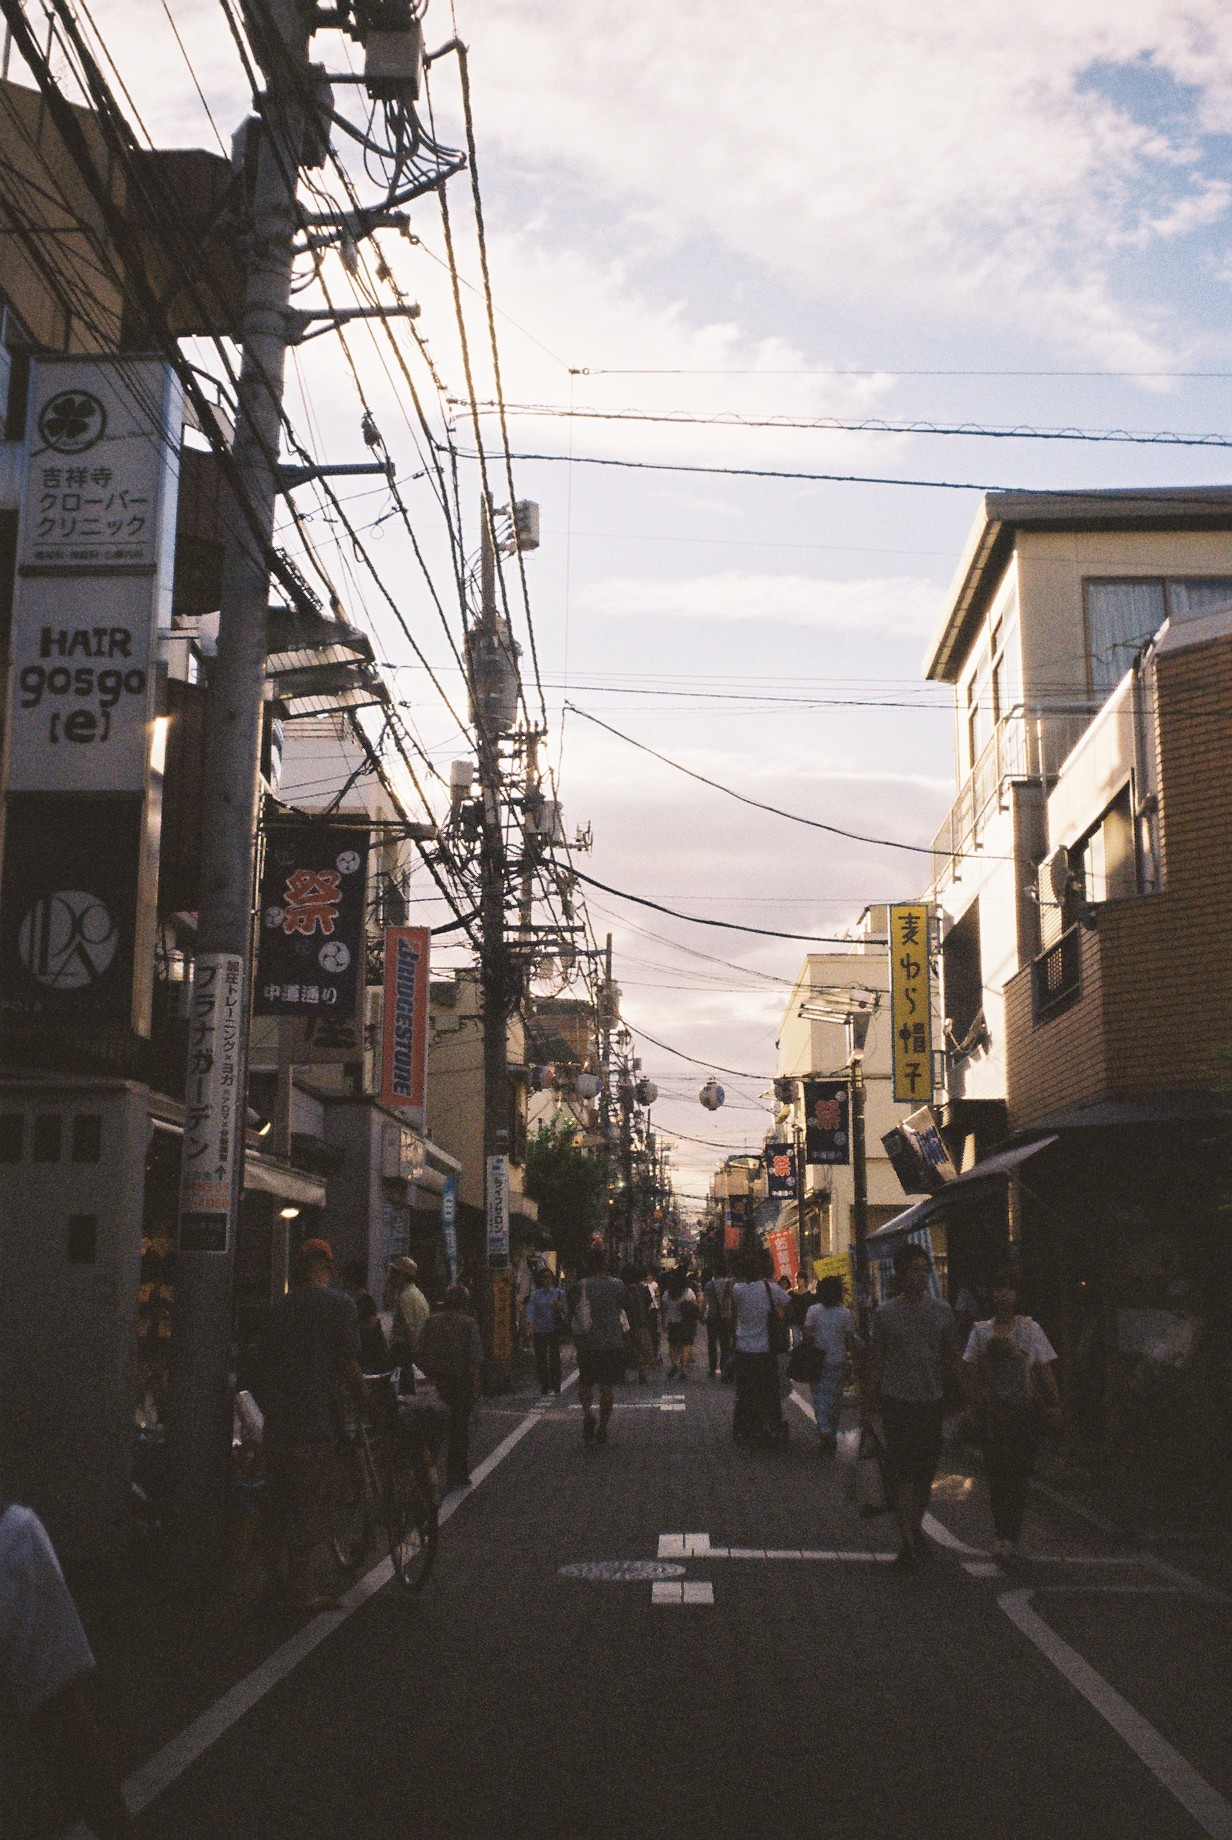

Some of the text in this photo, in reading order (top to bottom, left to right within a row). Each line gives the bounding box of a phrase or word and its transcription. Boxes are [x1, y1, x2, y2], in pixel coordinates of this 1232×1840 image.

[42, 466, 113, 488] 吉祥寺
[41, 489, 148, 513] クローバー
[37, 515, 146, 538] クリニック
[40, 627, 132, 658] HAIR
[20, 665, 146, 709] gosgo
[283, 868, 343, 935] 祭
[392, 937, 421, 1097] BRIDGESTONE
[897, 912, 926, 1094] 麦わら帽子
[187, 965, 218, 1160] プラナガーデン
